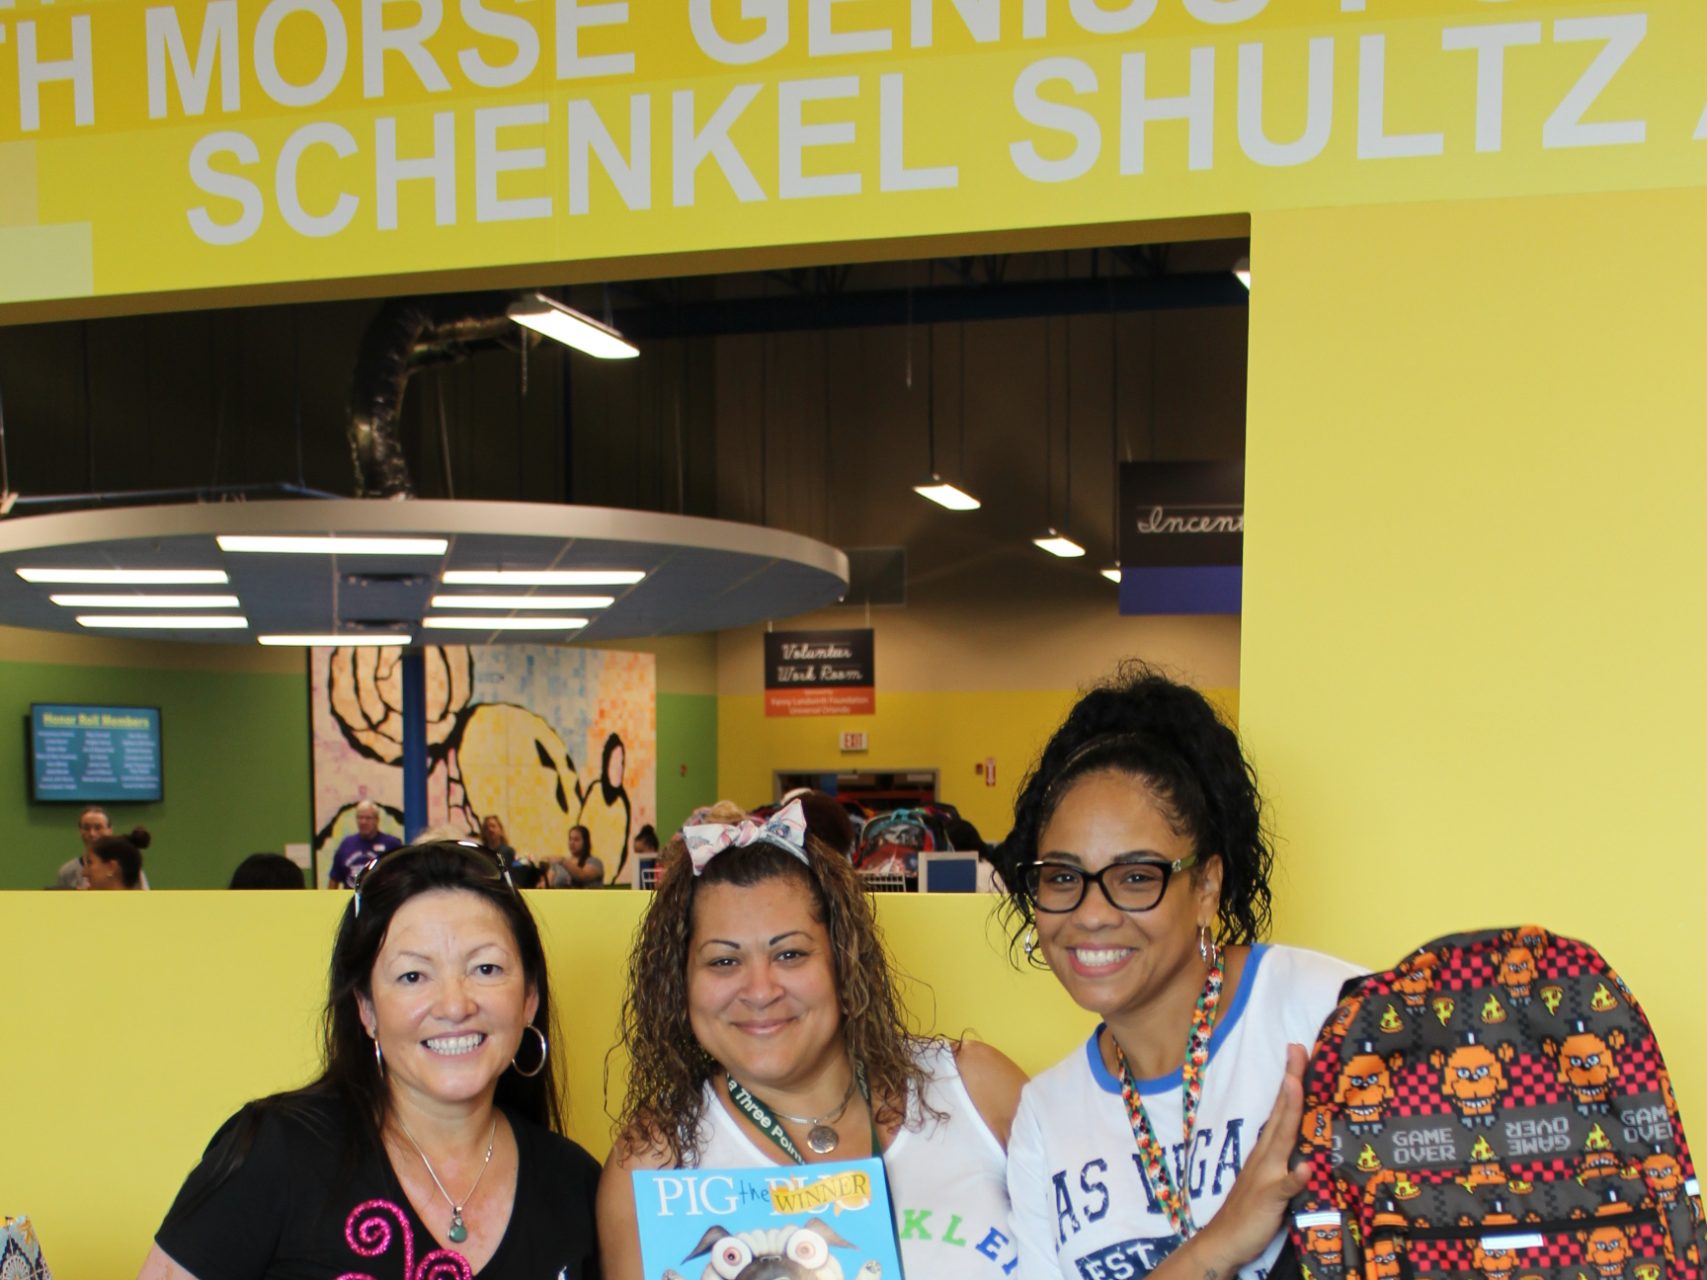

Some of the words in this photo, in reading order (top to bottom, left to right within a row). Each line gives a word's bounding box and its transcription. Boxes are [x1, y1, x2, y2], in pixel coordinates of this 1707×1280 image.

[0, 14, 95, 131] H
[145, 0, 636, 120] MORSE
[186, 73, 959, 246] SCHENKEL
[1009, 13, 1647, 182] SHULTZ
[781, 643, 852, 660] Volunteer
[777, 666, 817, 683] Work
[820, 664, 863, 681] Room
[844, 733, 863, 749] EXIT
[734, 1085, 771, 1128] Three
[1392, 1127, 1455, 1147] GAME
[1505, 1116, 1570, 1139] OVER
[1394, 1144, 1456, 1164] OVER
[1508, 1134, 1571, 1156] GAME
[652, 1175, 739, 1217] PIG
[738, 1179, 771, 1205] the
[774, 1173, 868, 1213] WINNER
[1052, 1157, 1110, 1247] AS
